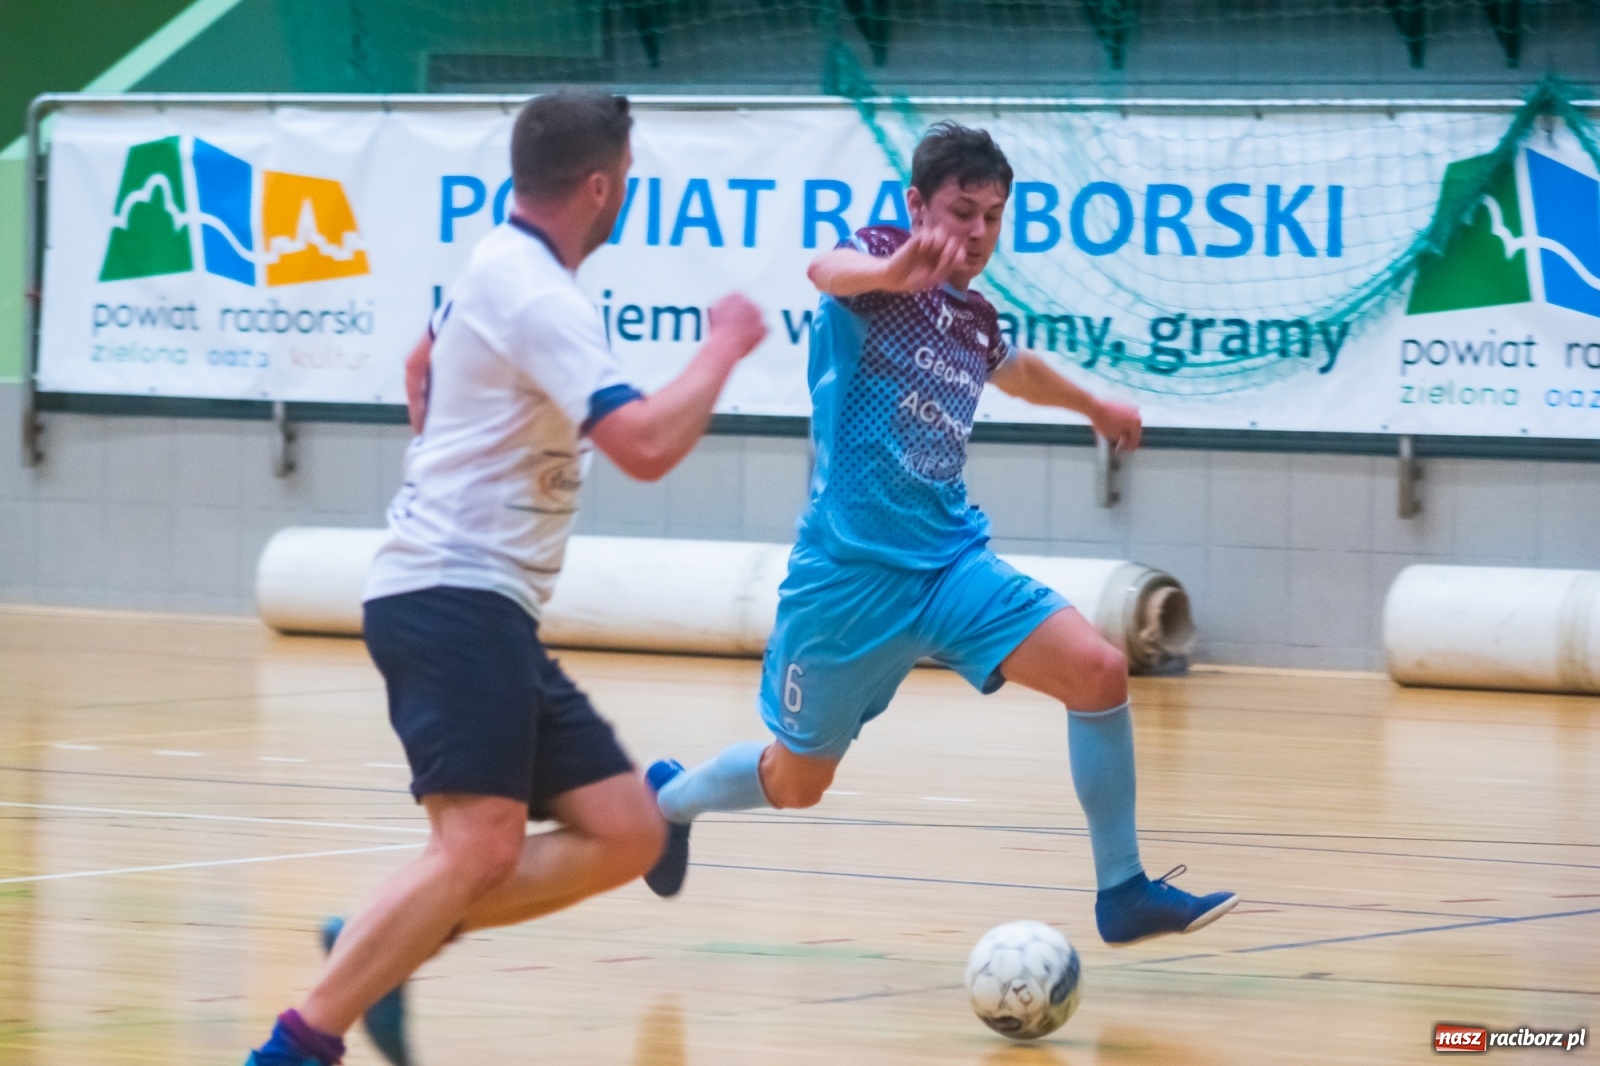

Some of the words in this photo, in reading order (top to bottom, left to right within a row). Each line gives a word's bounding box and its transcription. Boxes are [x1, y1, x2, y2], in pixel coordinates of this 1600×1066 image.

[802, 178, 1344, 258] RABORSKI
[92, 296, 199, 337] powiat
[91, 342, 188, 366] zielona
[207, 349, 270, 368] oaza
[1145, 313, 1349, 374] gramy
[1400, 328, 1538, 376] powiat
[1400, 379, 1519, 406] zielona
[784, 663, 803, 713] 6
